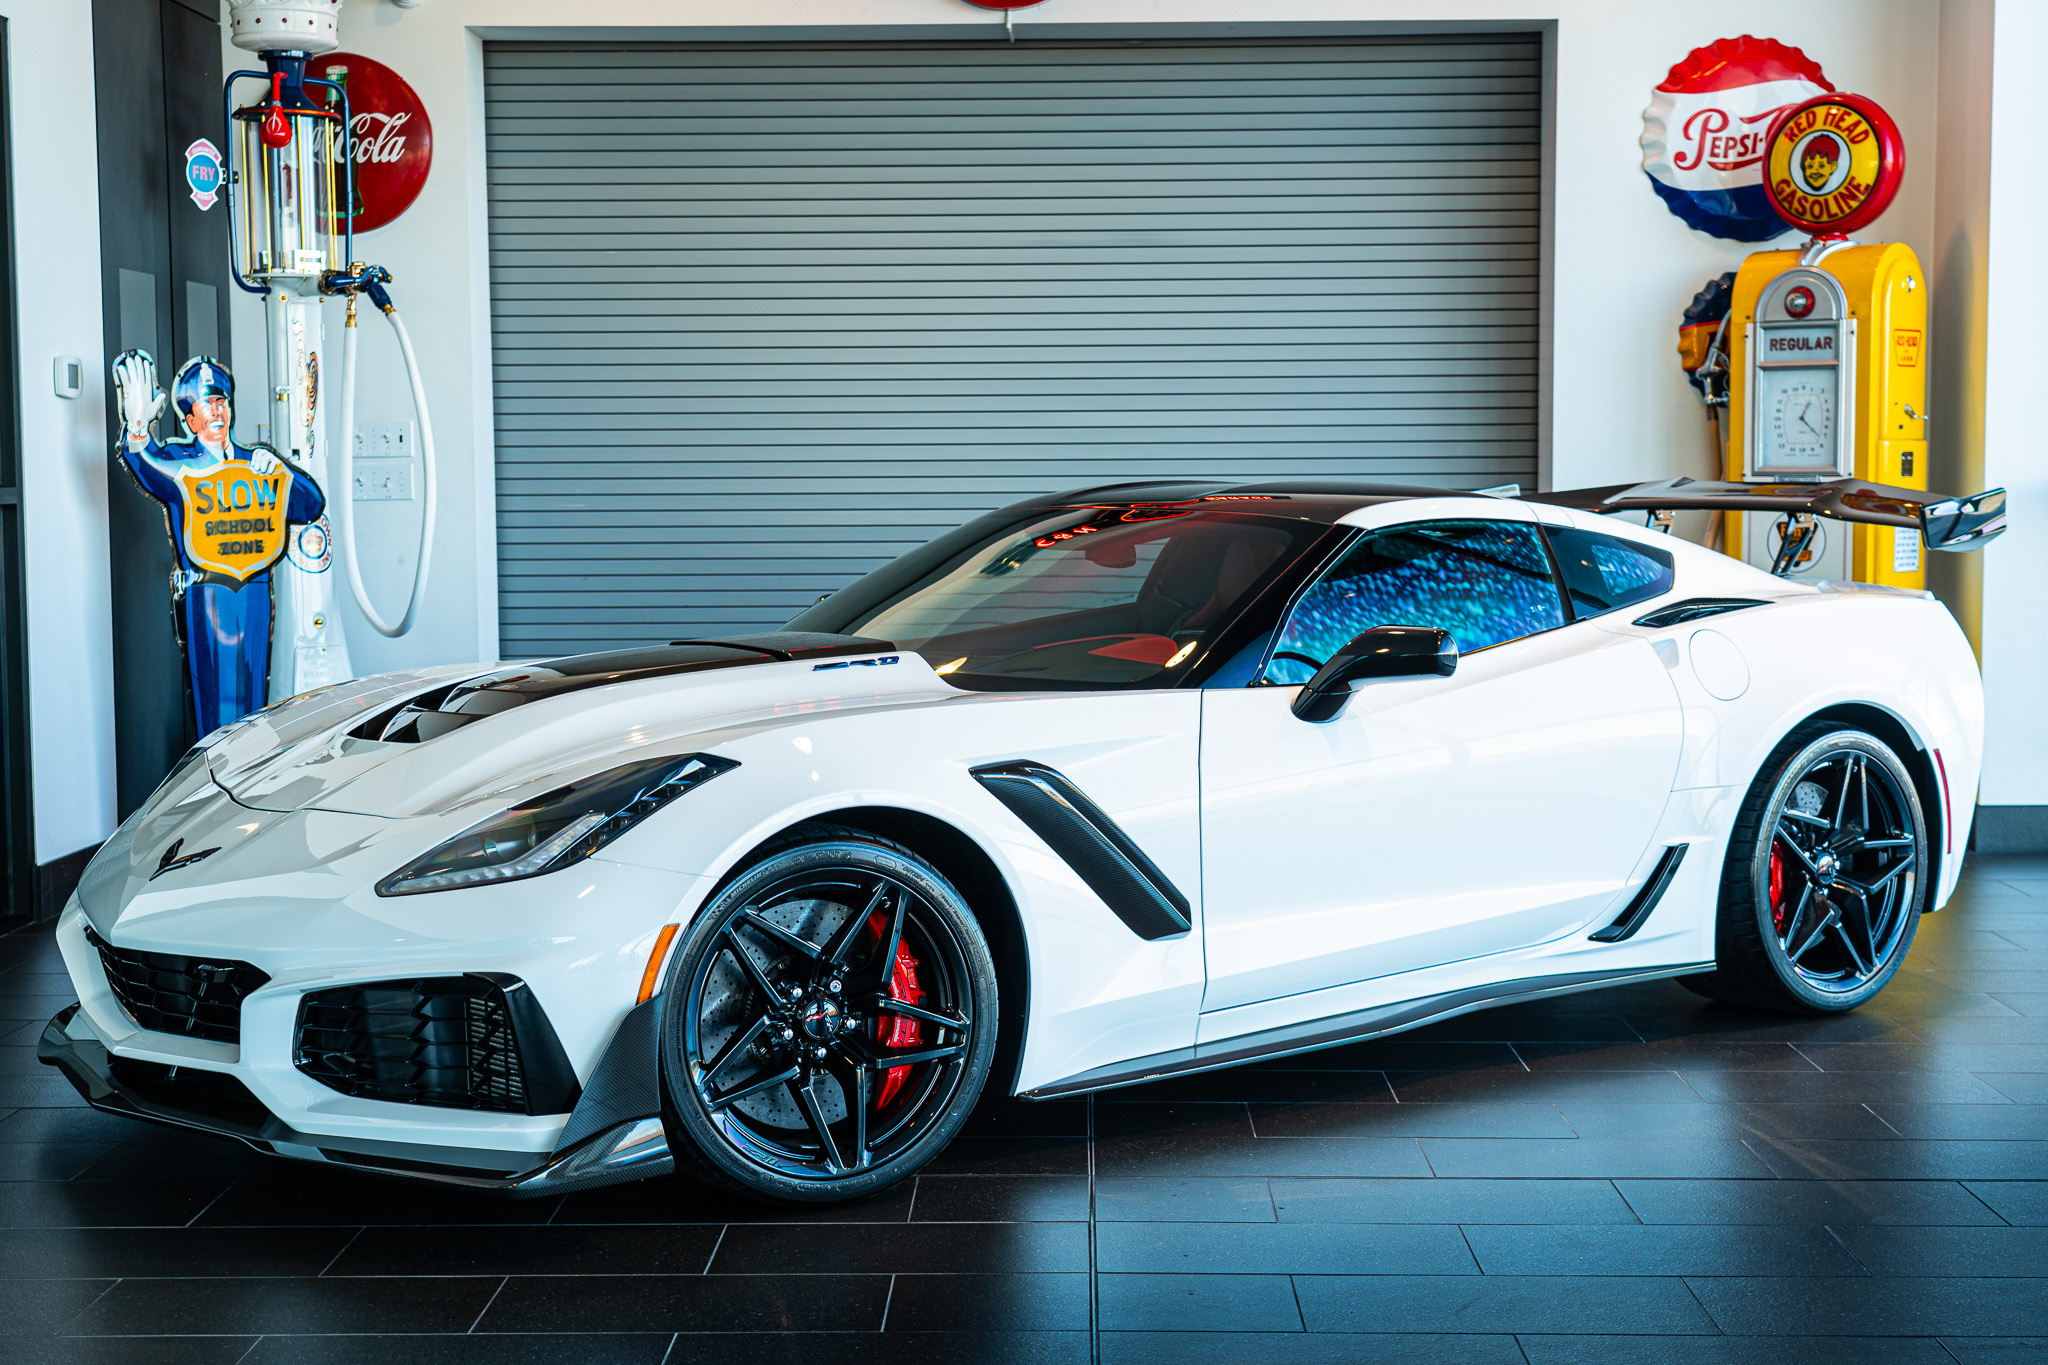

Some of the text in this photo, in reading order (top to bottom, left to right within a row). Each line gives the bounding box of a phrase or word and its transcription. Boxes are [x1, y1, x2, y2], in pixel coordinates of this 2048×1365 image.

[1783, 106, 1869, 145] RED HEAD
[192, 165, 216, 182] FRY
[1774, 175, 1871, 221] GASOLINE
[1769, 336, 1833, 351] REGULAR
[196, 478, 279, 515] SLOW
[205, 518, 275, 537] SCHOOL
[219, 540, 264, 555] ZONE
[730, 870, 764, 897] MICHELIN
